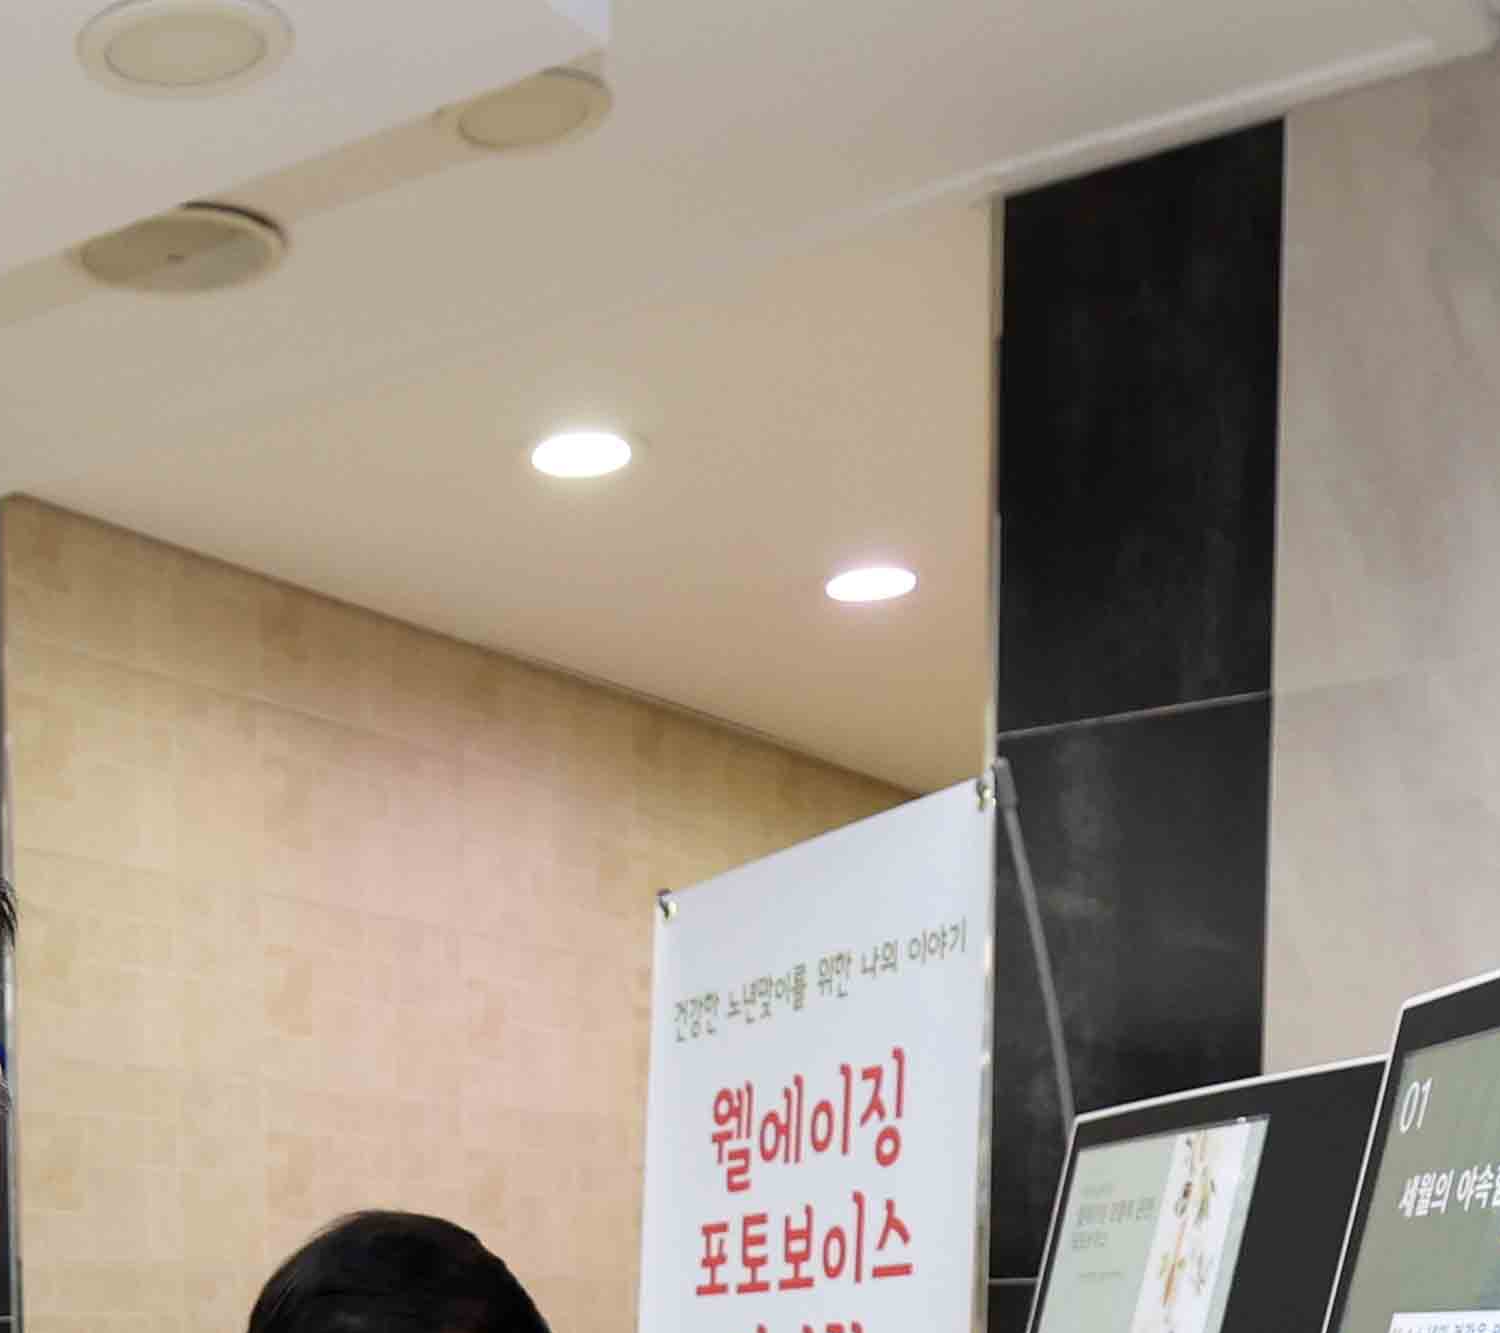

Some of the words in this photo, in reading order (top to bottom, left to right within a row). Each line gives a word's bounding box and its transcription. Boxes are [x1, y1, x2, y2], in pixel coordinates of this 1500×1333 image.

[675, 992, 720, 1042] 건강한
[817, 947, 855, 998] 위한
[860, 939, 899, 980] 나의
[908, 915, 968, 966] 이야기
[711, 1046, 906, 1194] 웰에이징
[1399, 1078, 1433, 1133] 01
[695, 1190, 914, 1297] 포토보이스
[1399, 1169, 1452, 1217] 세월의
